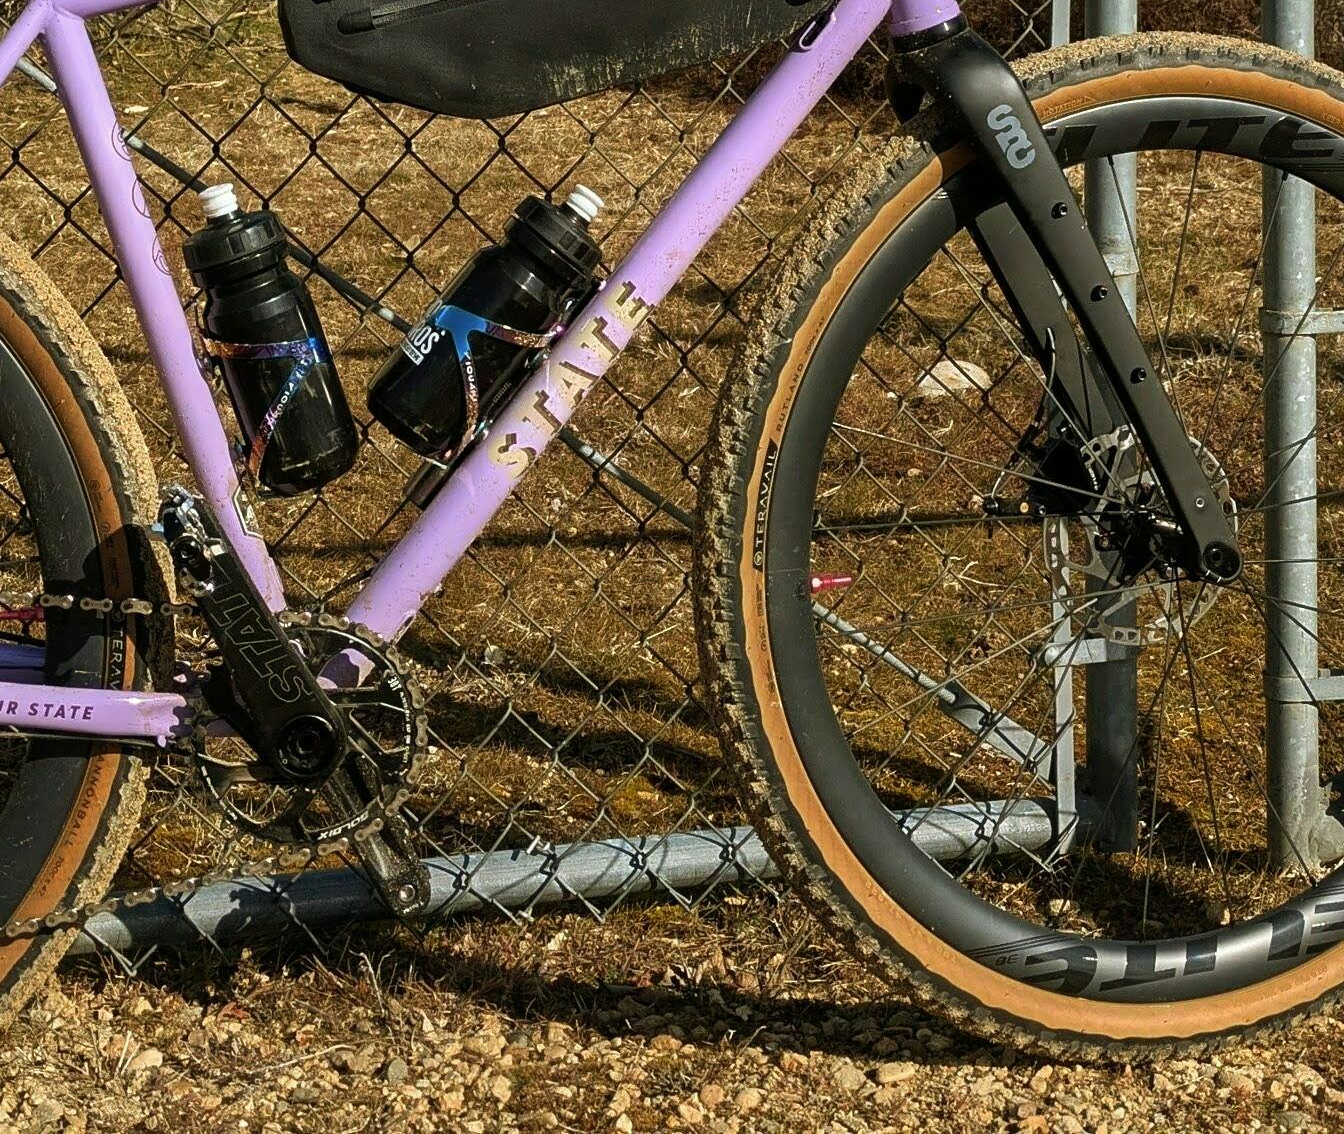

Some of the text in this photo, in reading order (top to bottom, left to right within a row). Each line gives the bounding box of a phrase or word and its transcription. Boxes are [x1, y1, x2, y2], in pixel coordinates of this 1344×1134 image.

[1045, 116, 1339, 168] LITE
[488, 281, 656, 479] STATE
[757, 449, 778, 545] TERAVAIL
[776, 363, 805, 432] RUTLAND
[28, 703, 94, 720] STATE
[317, 810, 369, 841] GOLDIX
